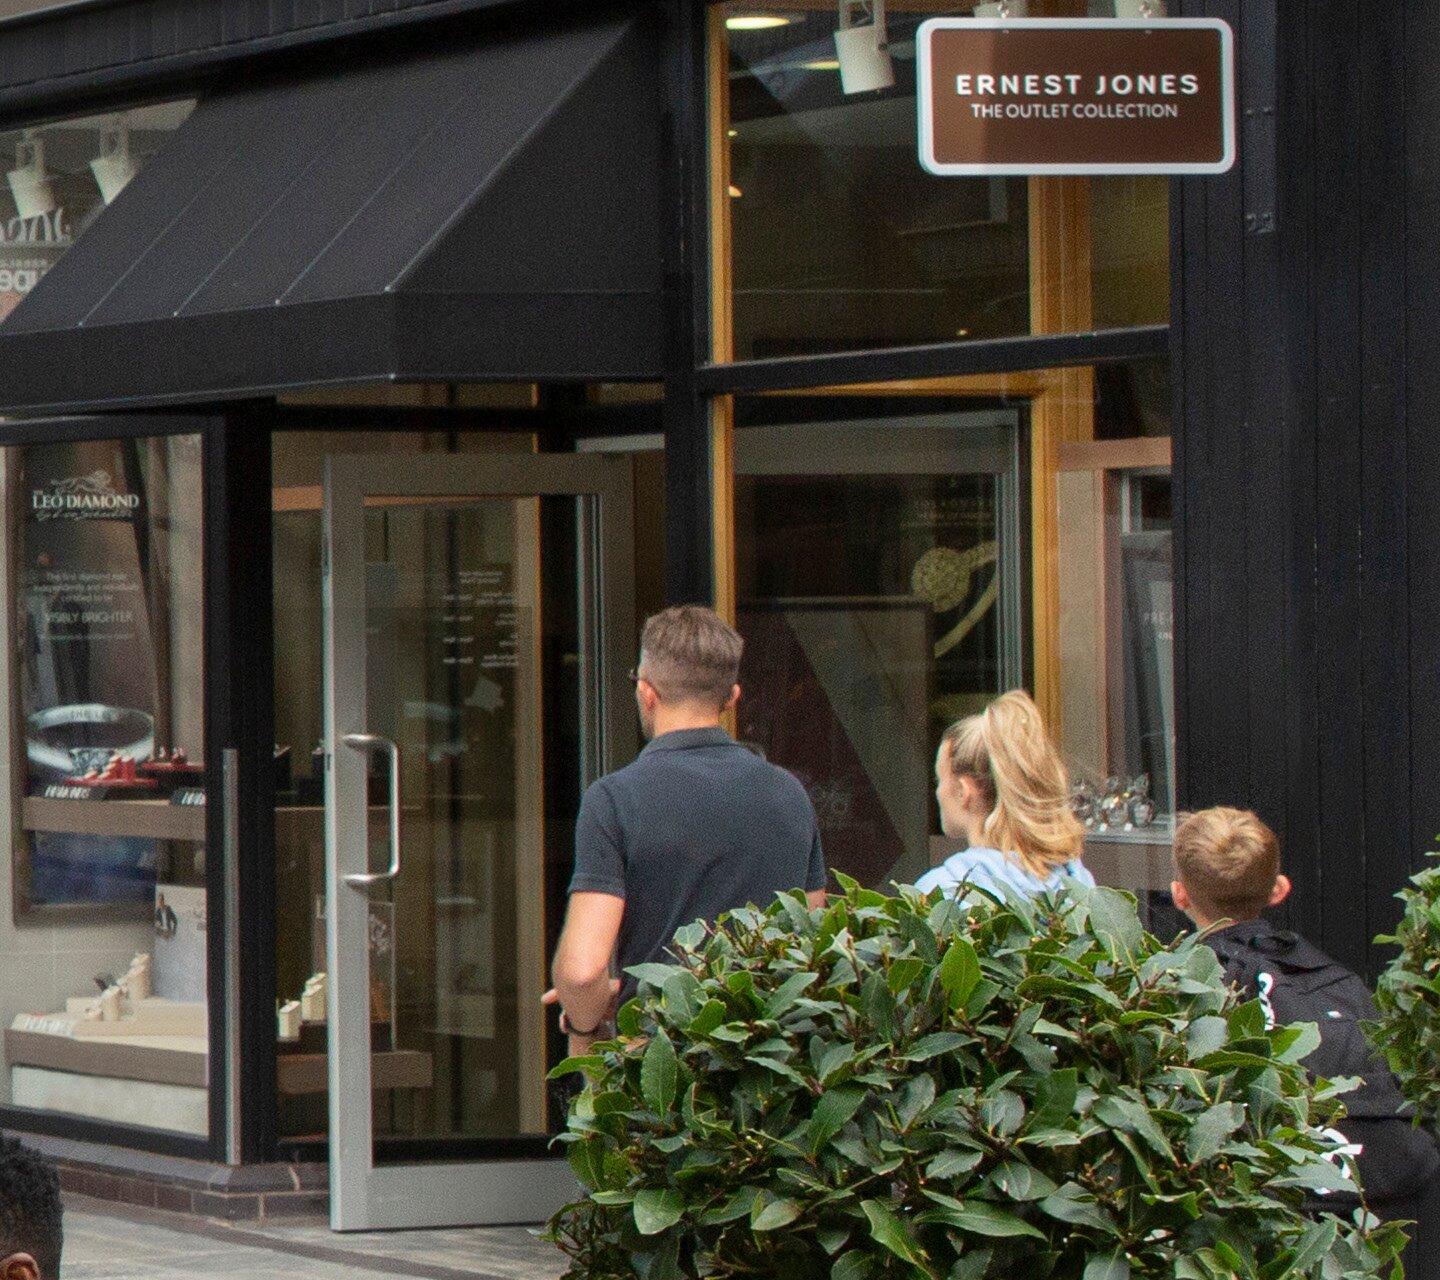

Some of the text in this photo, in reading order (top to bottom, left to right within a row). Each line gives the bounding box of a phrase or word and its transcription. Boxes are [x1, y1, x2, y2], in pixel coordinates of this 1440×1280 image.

[955, 74, 1200, 96] ERNEST JONES
[971, 103, 1179, 119] THE OUTLET COLLECTION
[32, 493, 140, 509] LEO DIAMOND
